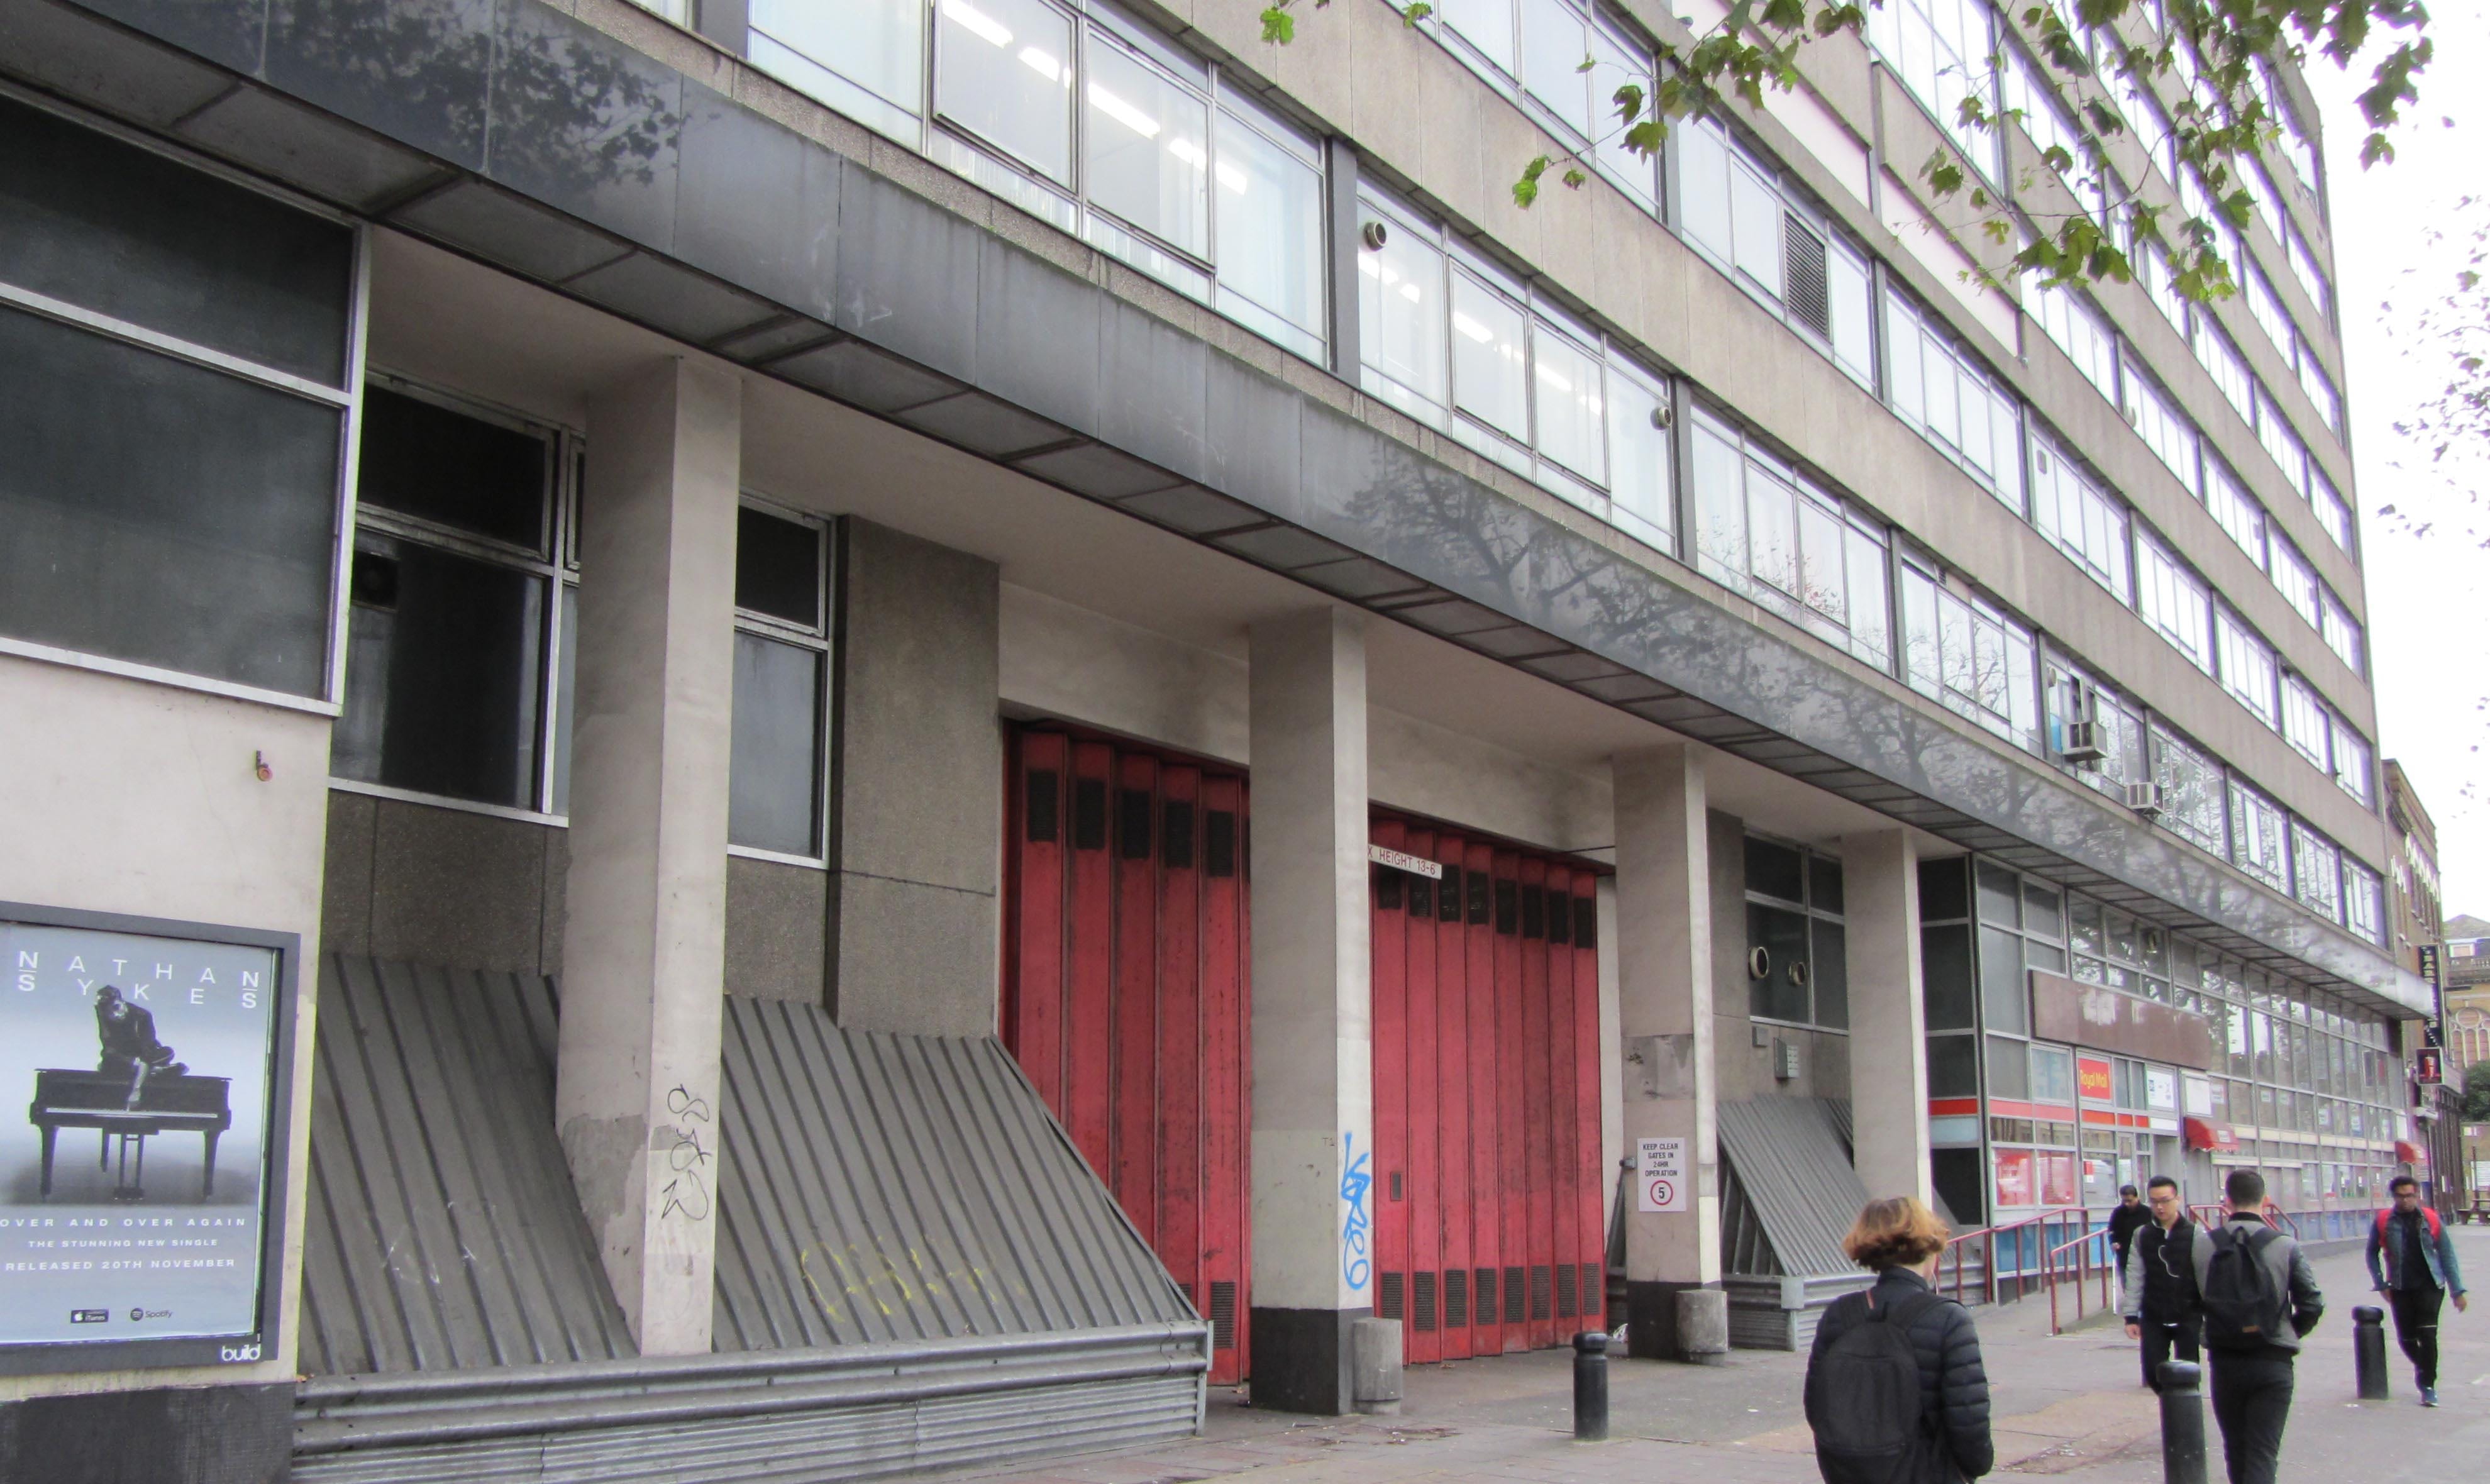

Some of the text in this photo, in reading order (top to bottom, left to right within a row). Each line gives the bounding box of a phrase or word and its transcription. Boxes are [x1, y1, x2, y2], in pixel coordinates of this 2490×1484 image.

[1379, 848, 1413, 868] HEIGHT
[19, 950, 260, 988] NATHAN
[18, 974, 257, 1009] SYKES
[2079, 1070, 2108, 1089] Royal Mail
[1658, 1187, 1665, 1199] 5
[0, 1218, 245, 1227] OVER AND OVER AGAIN
[172, 1239, 218, 1247] SINGLE
[6, 1259, 235, 1271] RELEASED 20TH NOVEMBER
[221, 1343, 262, 1362] build
